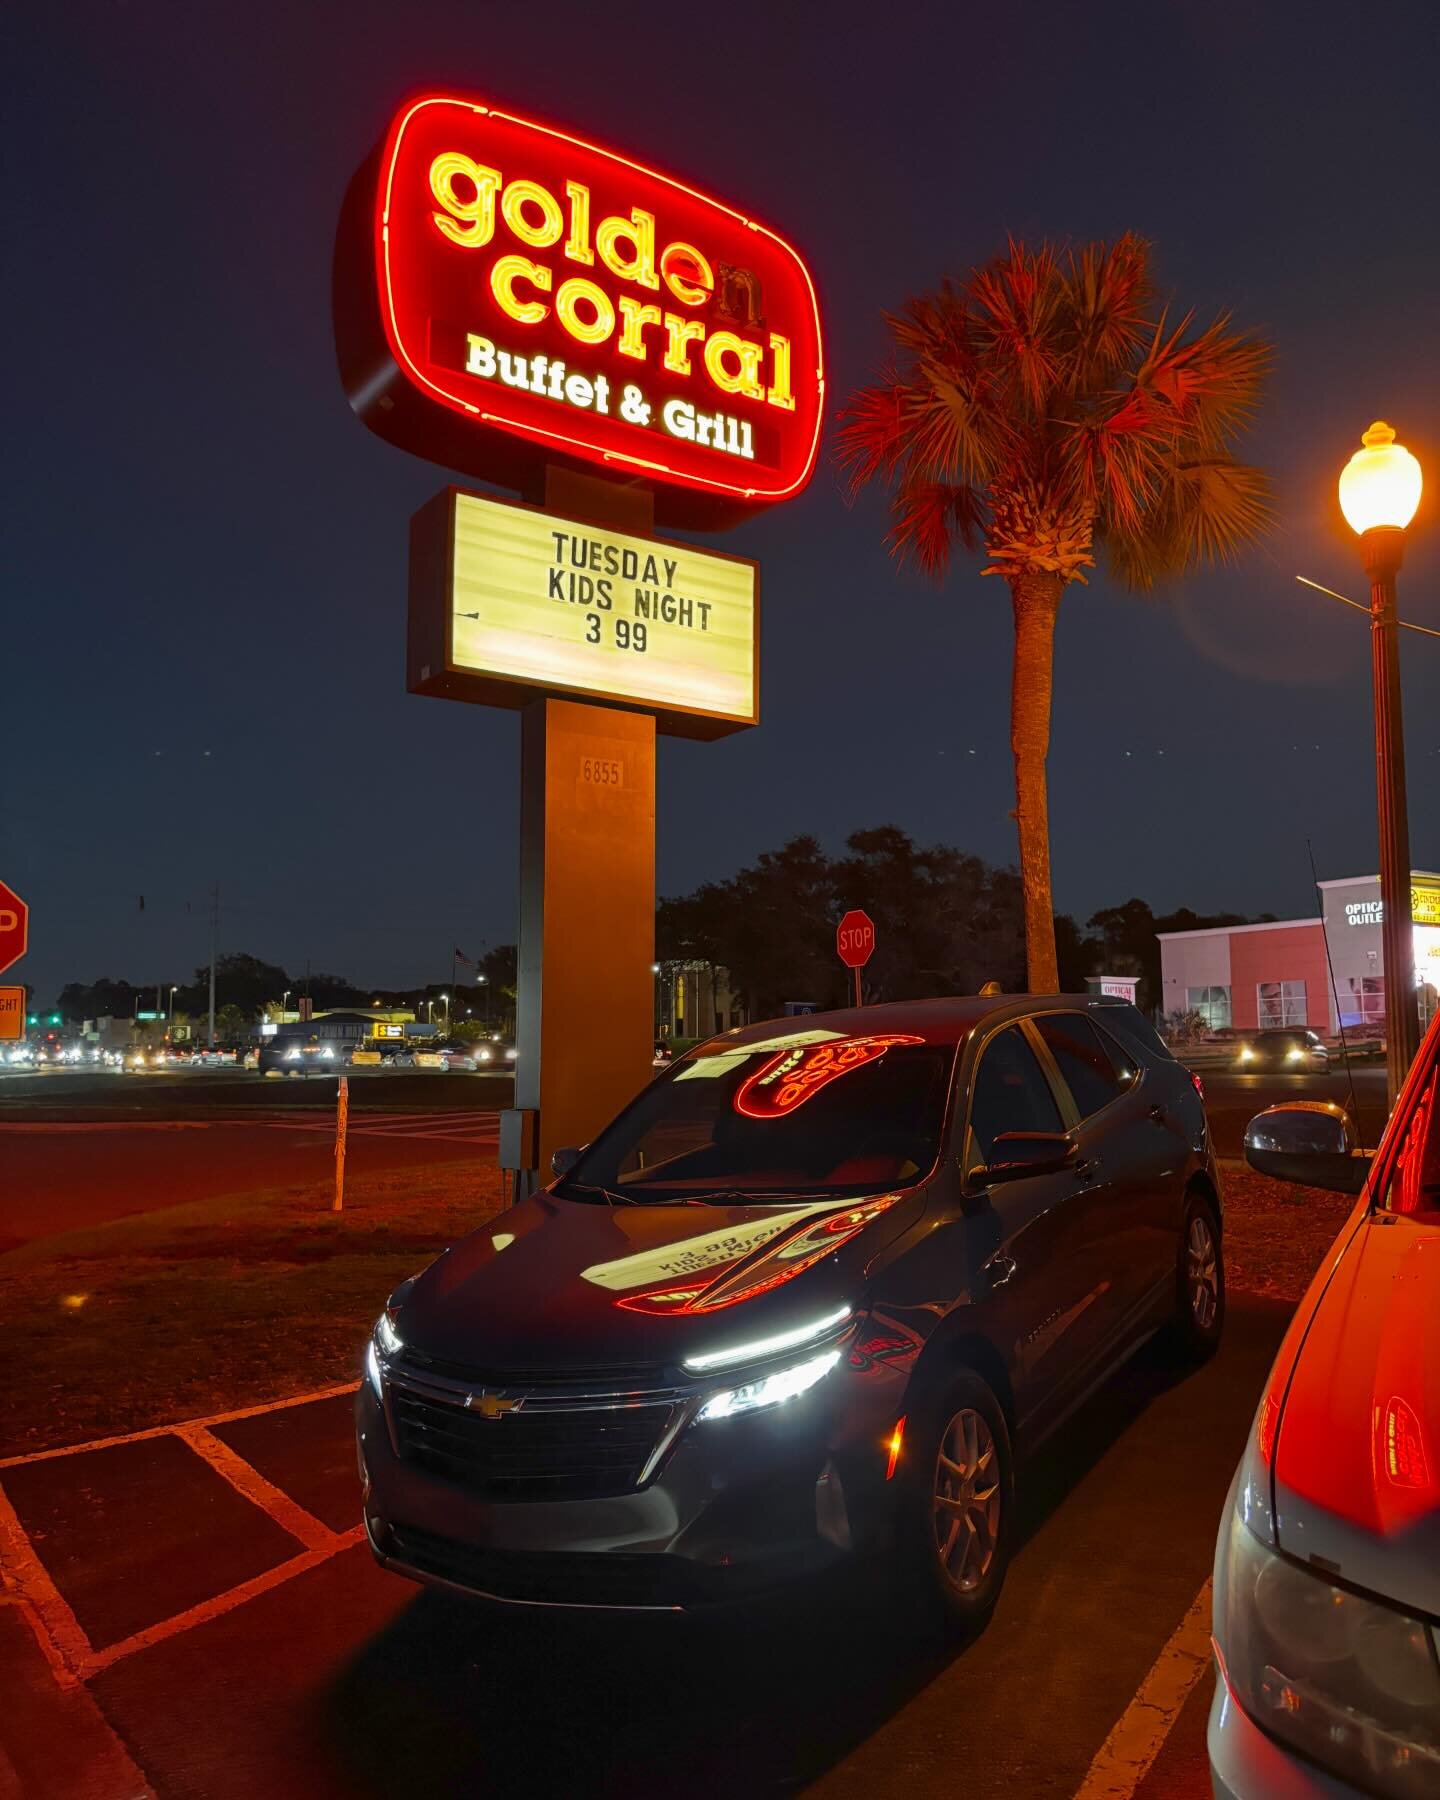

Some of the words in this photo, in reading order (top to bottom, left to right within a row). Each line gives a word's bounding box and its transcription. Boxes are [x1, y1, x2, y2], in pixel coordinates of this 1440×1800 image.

[429, 152, 767, 331] golden
[490, 255, 795, 411] corral
[465, 333, 609, 413] Buffet
[620, 384, 651, 426] &
[663, 400, 755, 459] Grill
[552, 532, 677, 589] TUESDAY
[549, 568, 613, 611] KIDS
[635, 588, 712, 631] NIGHT
[586, 613, 601, 644] 3
[615, 619, 647, 652] 99
[584, 760, 618, 784] 6855
[1345, 901, 1383, 915] OPTICA
[1348, 912, 1384, 925] OUTLE
[840, 926, 871, 950] STOP
